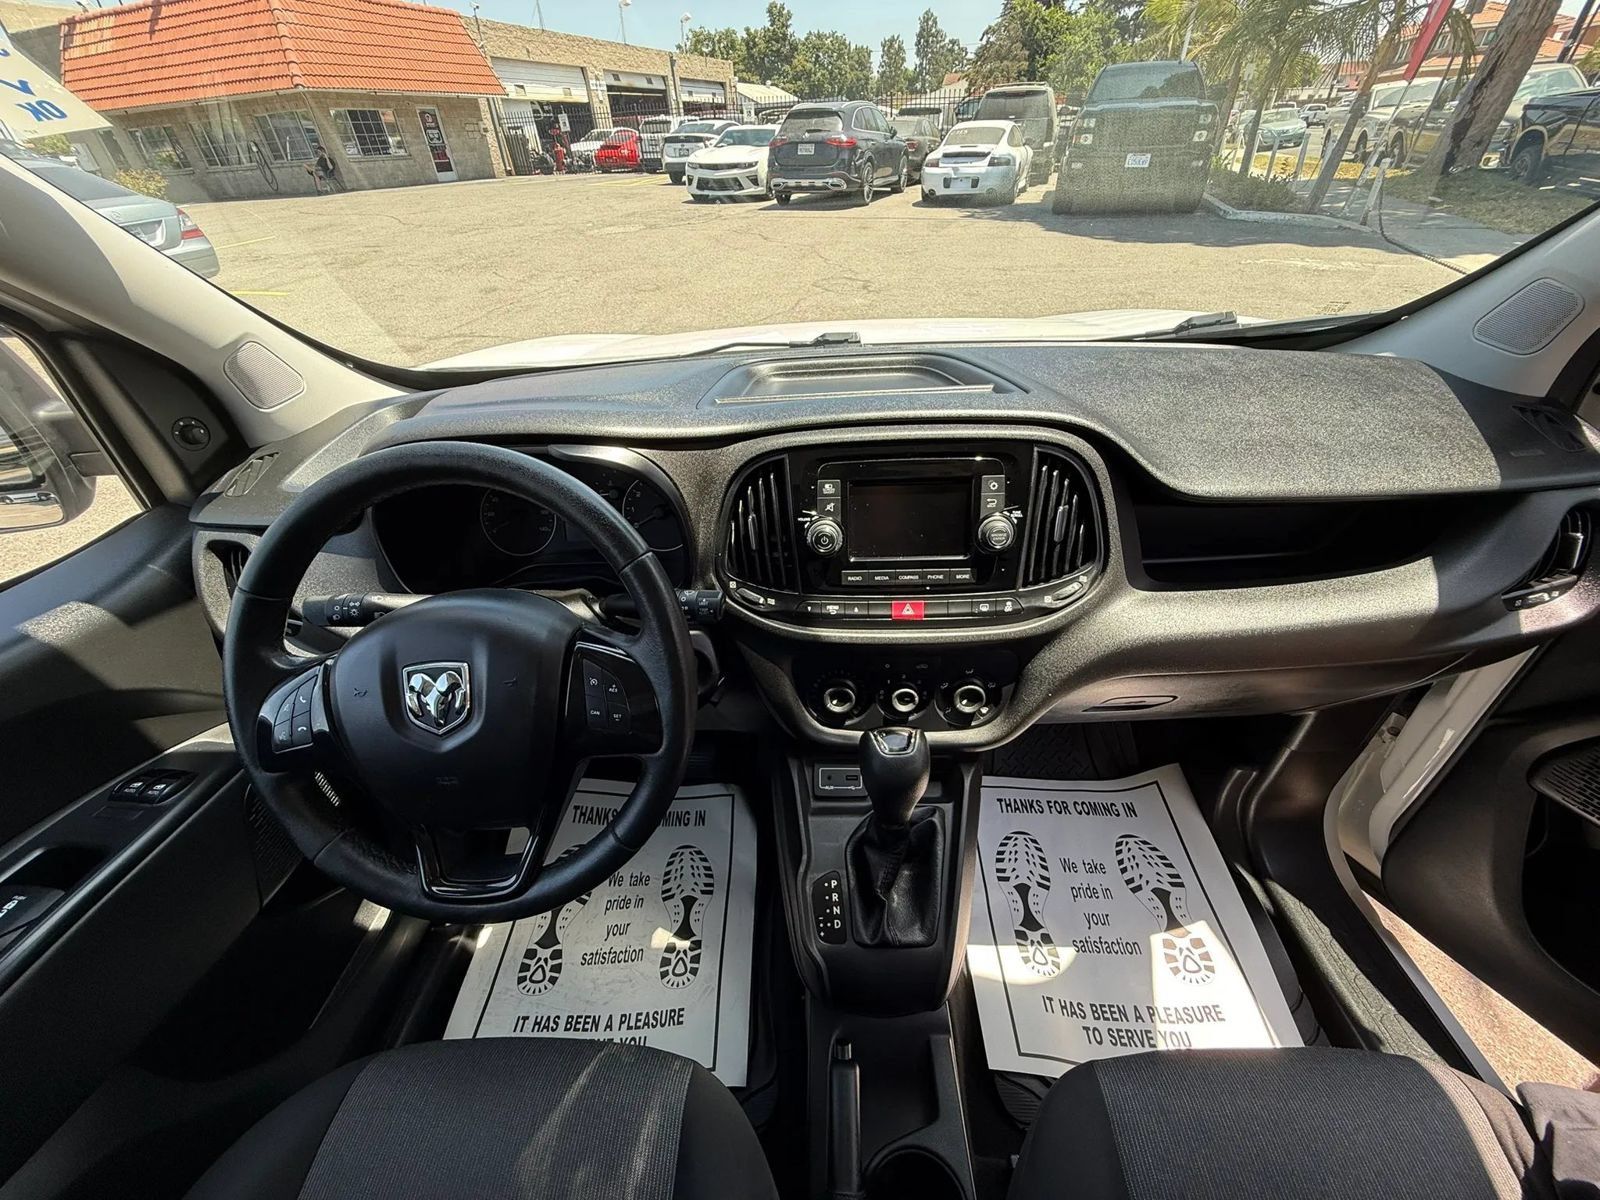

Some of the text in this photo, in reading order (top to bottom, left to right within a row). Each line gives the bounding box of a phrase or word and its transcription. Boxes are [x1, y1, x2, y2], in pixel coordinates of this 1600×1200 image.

[996, 797, 1138, 818] THANKS FOR COMING IN
[694, 809, 707, 827] IN
[1059, 857, 1107, 875] We take
[629, 871, 651, 887] take
[831, 879, 838, 889] P
[832, 892, 839, 902] R
[1070, 882, 1114, 903] pride in
[604, 894, 644, 916] pride in
[833, 905, 841, 915] N
[834, 919, 842, 929] D
[1083, 911, 1110, 930] your
[604, 922, 631, 942] your
[1072, 935, 1142, 955] satisfaction
[580, 945, 644, 966] satisfaction
[512, 1007, 685, 1033] IT HAS BEEN A PLEASURE
[1041, 995, 1226, 1025] IT HAS BEEN A PLEASURE
[1081, 1025, 1193, 1049] TO SERVE YOU
